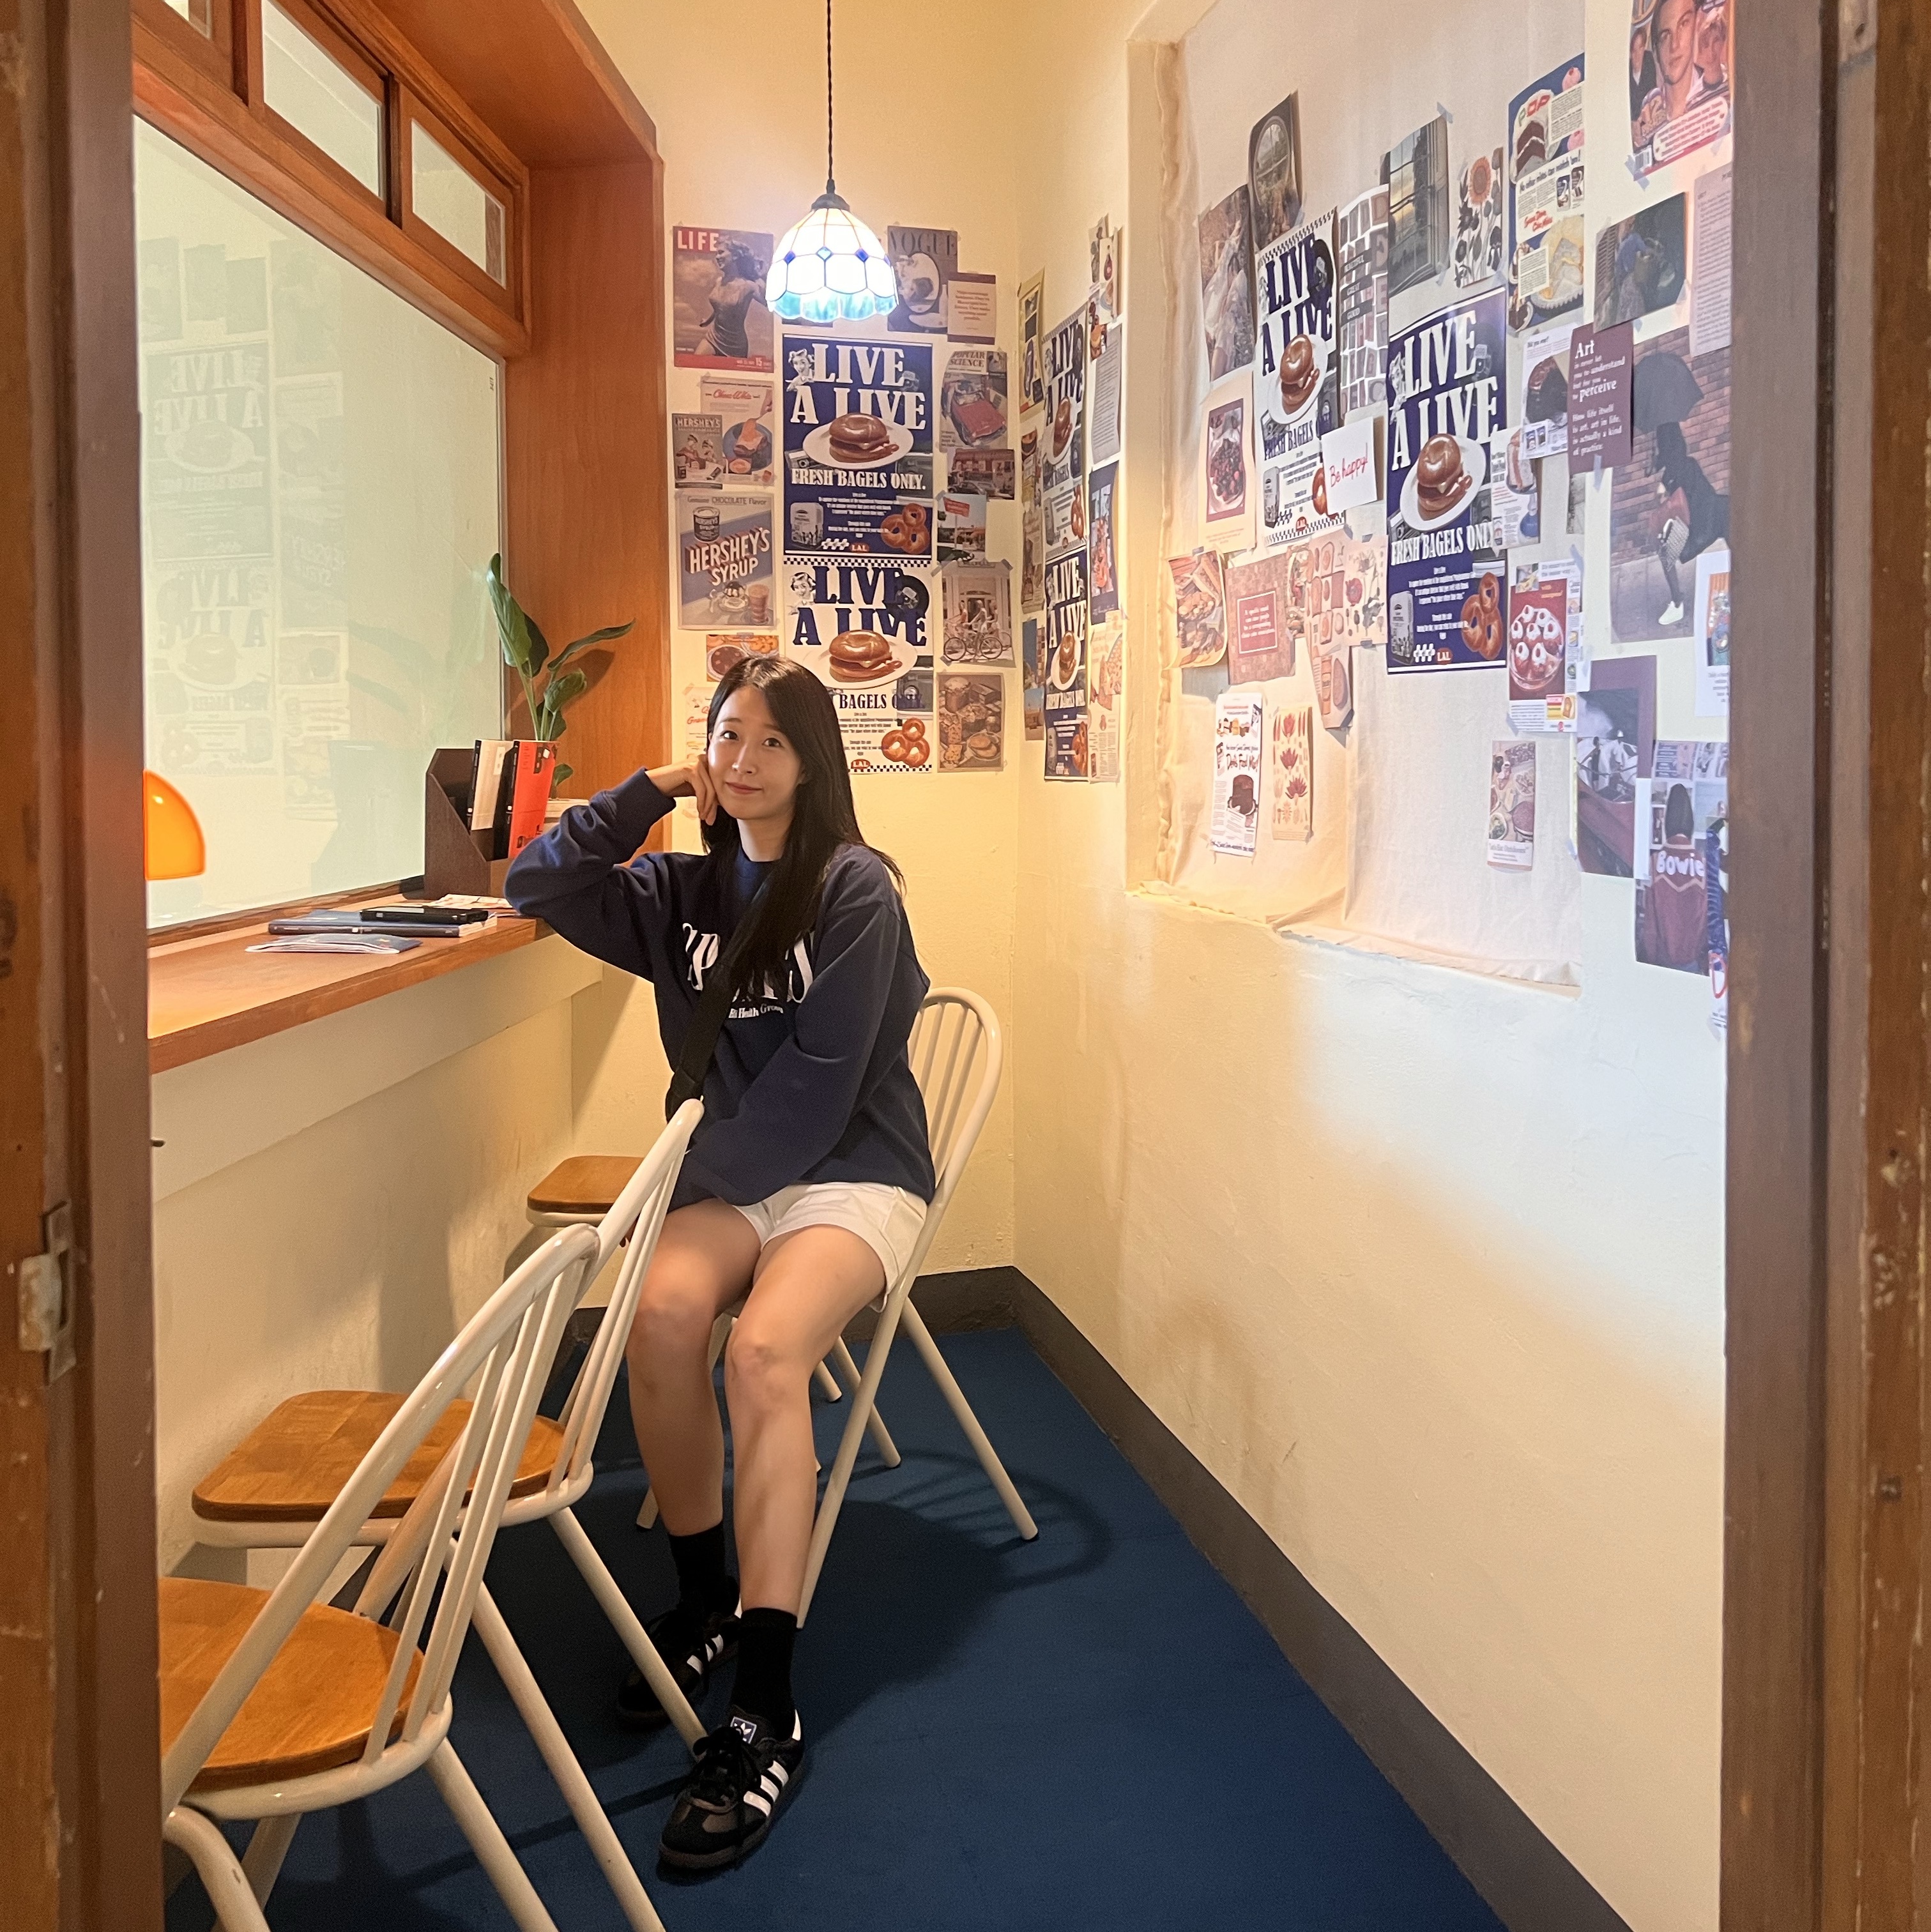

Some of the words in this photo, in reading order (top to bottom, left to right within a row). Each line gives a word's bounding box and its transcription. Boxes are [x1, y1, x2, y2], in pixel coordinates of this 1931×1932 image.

[678, 230, 719, 252] LIFE
[890, 230, 958, 256] VOGUE
[949, 358, 984, 368] SCIENCE
[950, 351, 985, 360] POPULAR
[1262, 322, 1276, 377] A
[1404, 310, 1477, 399] LIVE
[1575, 340, 1595, 359] Art
[812, 344, 904, 386] LIVE
[1579, 378, 1617, 402] perceive
[791, 386, 819, 425] A
[834, 388, 927, 430] LIVE
[1046, 384, 1054, 427] A
[676, 418, 721, 429] HERSHEY'S
[1288, 420, 1313, 452] BAGELS
[1392, 408, 1411, 471] A
[1418, 376, 1499, 448] LIVE
[791, 468, 834, 485] FRESH
[837, 470, 887, 488] BAGELS
[890, 473, 926, 490] ONLY.
[1330, 465, 1341, 487] Be
[1342, 443, 1368, 480] happy!
[712, 496, 747, 505] CHOCOLATE
[689, 527, 771, 574] HERSHEY'S
[1391, 534, 1421, 566] FRESH
[1422, 526, 1464, 560] BAGELS
[1466, 521, 1490, 551] ONL
[712, 557, 759, 586] SYRUP
[1053, 556, 1081, 602] LIVE
[792, 607, 821, 646] A
[836, 607, 927, 646] LIVE
[1048, 610, 1058, 649] A
[1437, 651, 1452, 662] LAL
[839, 694, 887, 709] BAGELS
[1656, 850, 1705, 877] Bowie
